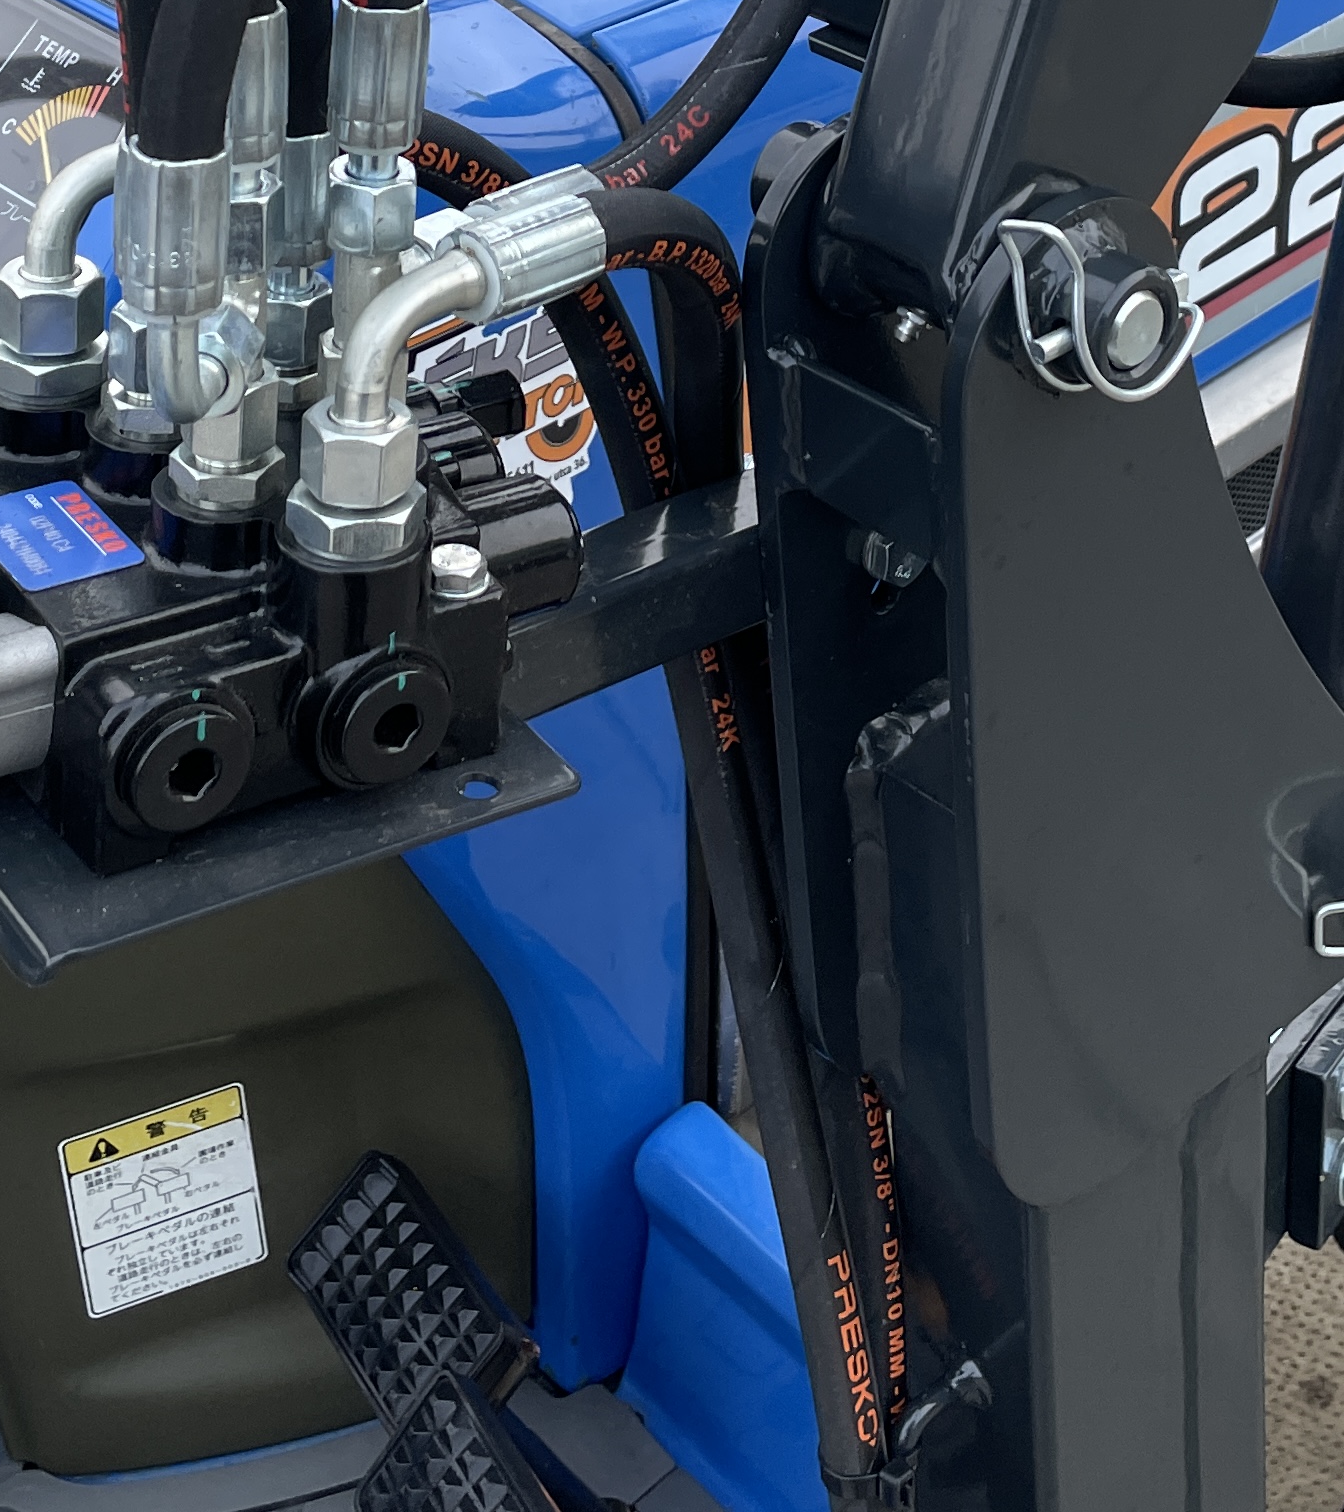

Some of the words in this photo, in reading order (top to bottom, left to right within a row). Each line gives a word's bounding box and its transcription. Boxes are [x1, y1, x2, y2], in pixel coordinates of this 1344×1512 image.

[33, 34, 81, 68] TEMP
[106, 67, 124, 86] H
[1, 118, 17, 135] C
[660, 105, 711, 157] 24C
[626, 381, 657, 433] 330
[642, 433, 670, 480] bar
[56, 492, 129, 554] PRESKO
[700, 646, 720, 673] ar
[711, 692, 742, 753] 24K
[862, 1092, 887, 1150] 2SN
[872, 1154, 896, 1212] 3/8"
[882, 1238, 904, 1321] DN10
[827, 1248, 880, 1448] PRESKO
[888, 1325, 906, 1379] MM
